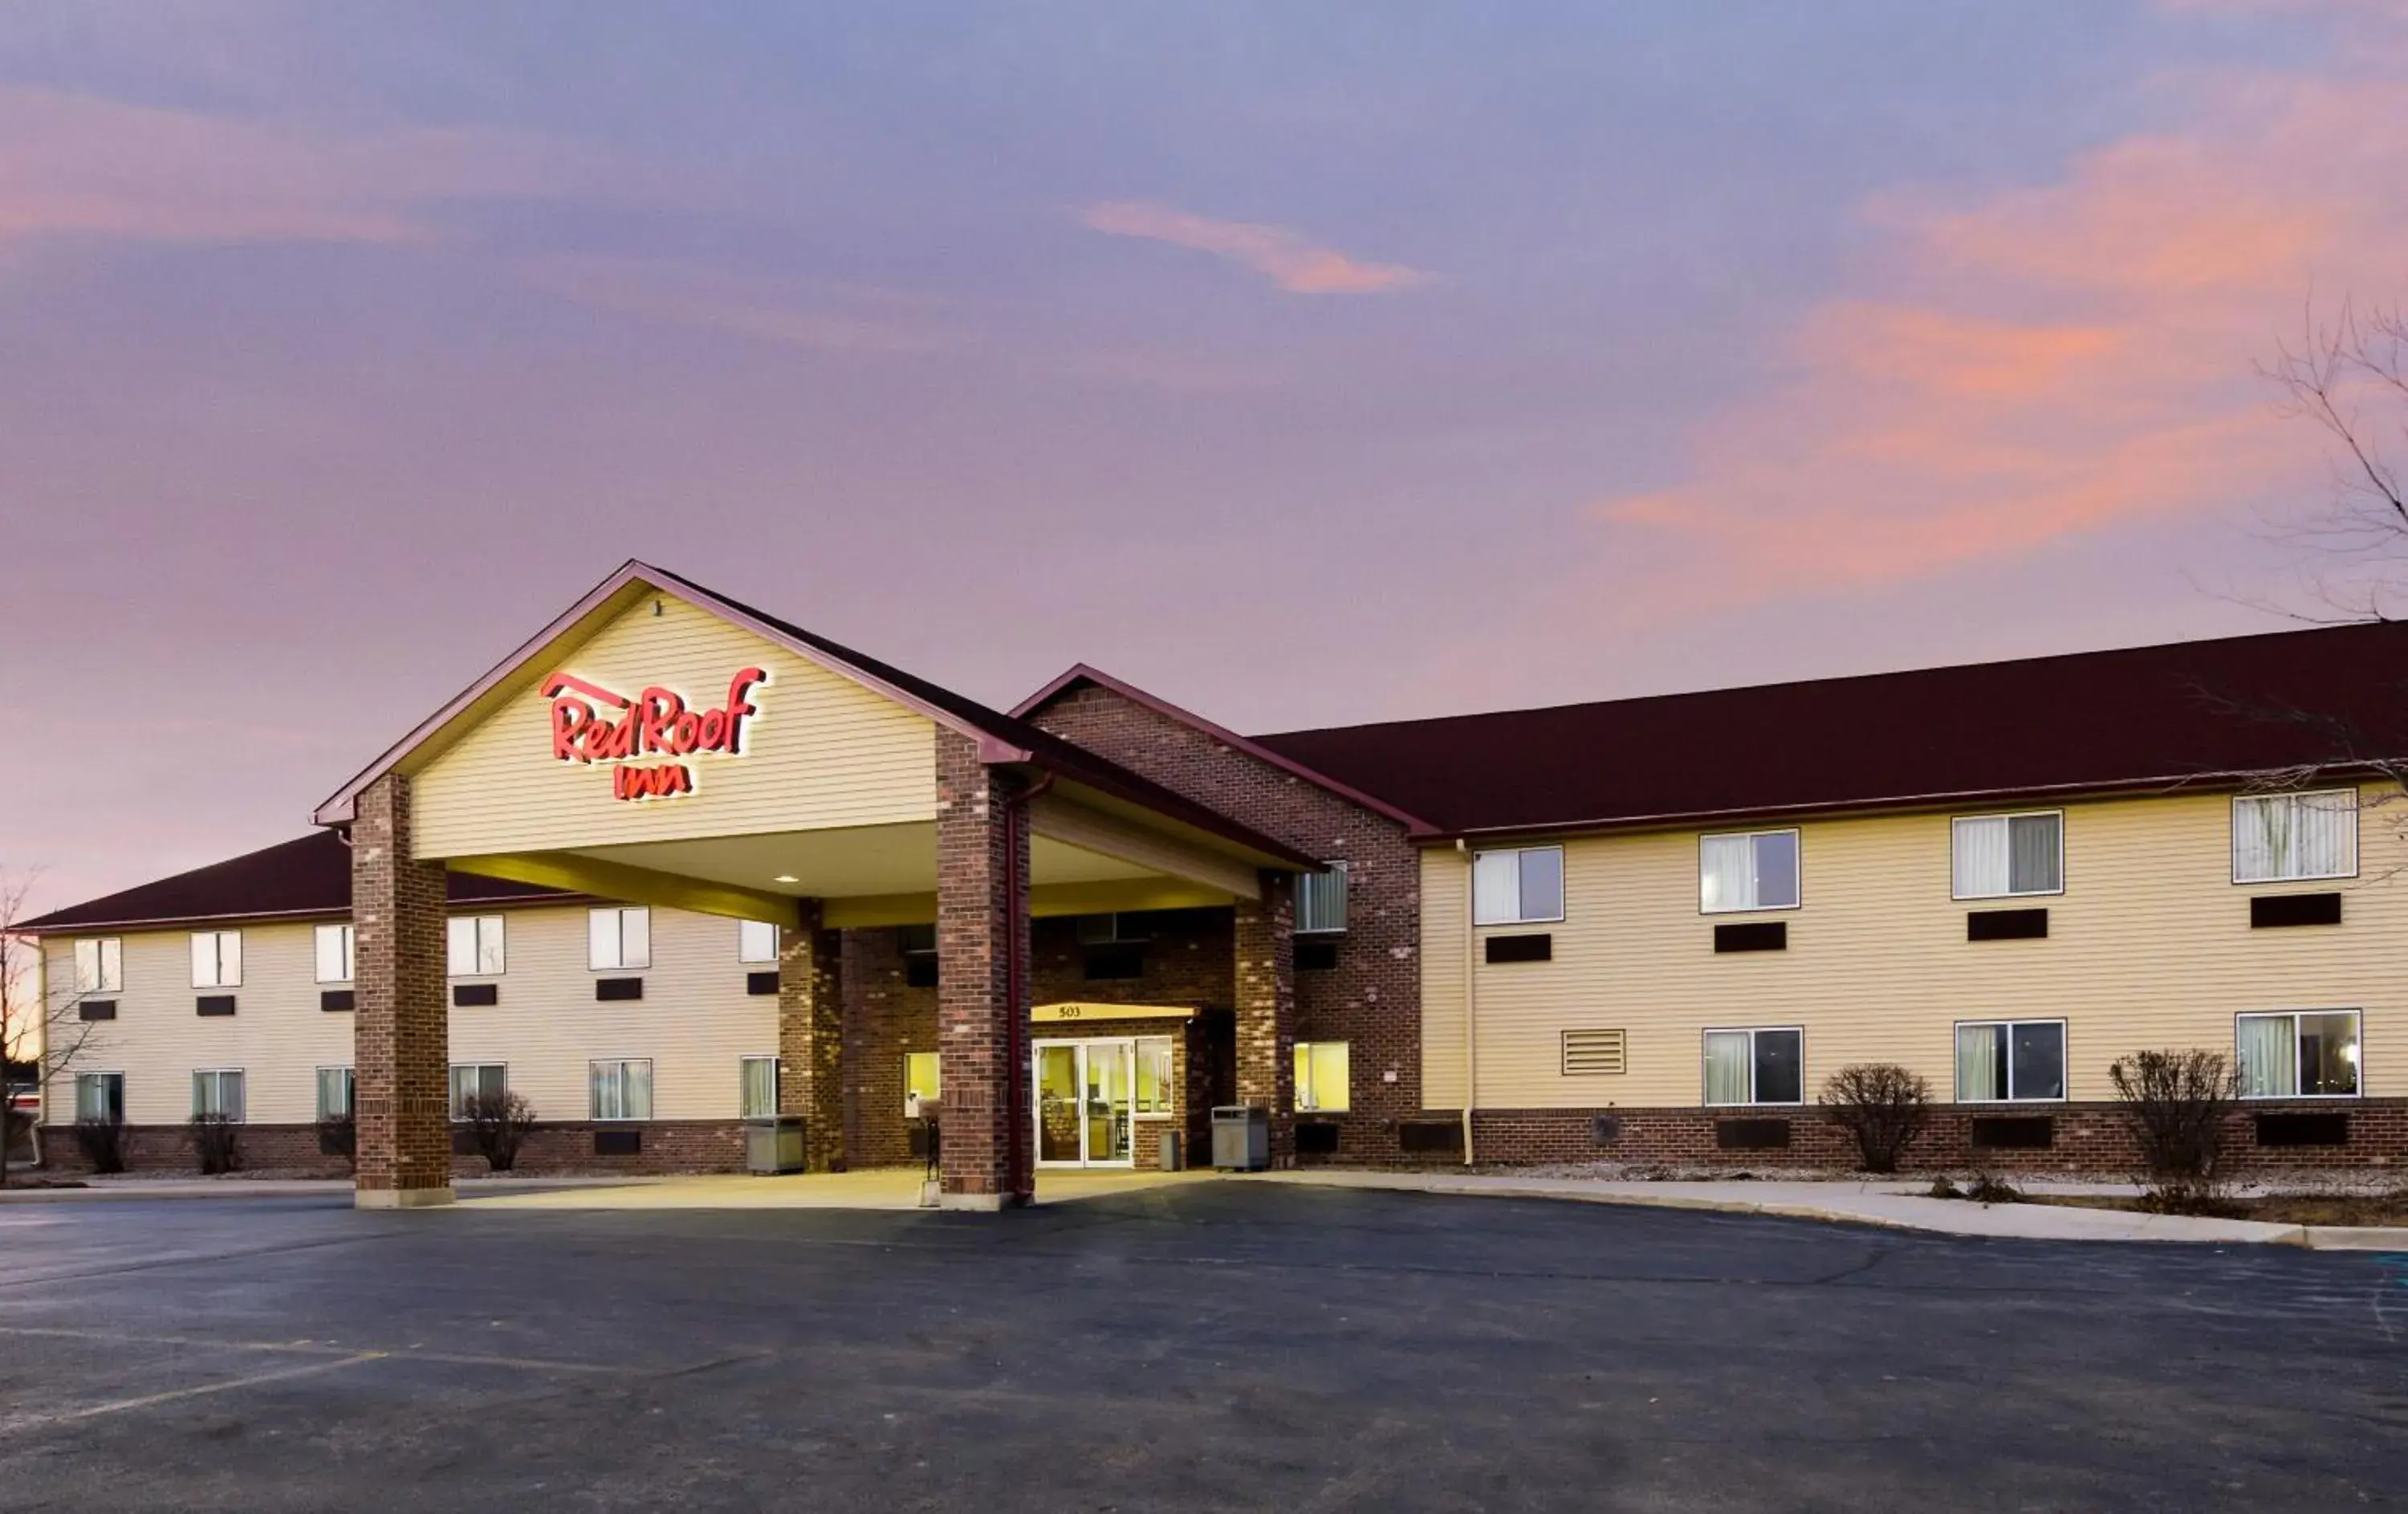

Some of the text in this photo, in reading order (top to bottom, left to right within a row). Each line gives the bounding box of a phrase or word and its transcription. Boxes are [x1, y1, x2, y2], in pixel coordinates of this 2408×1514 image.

[551, 667, 767, 763] Red Roof
[1059, 1006, 1080, 1017] 503
